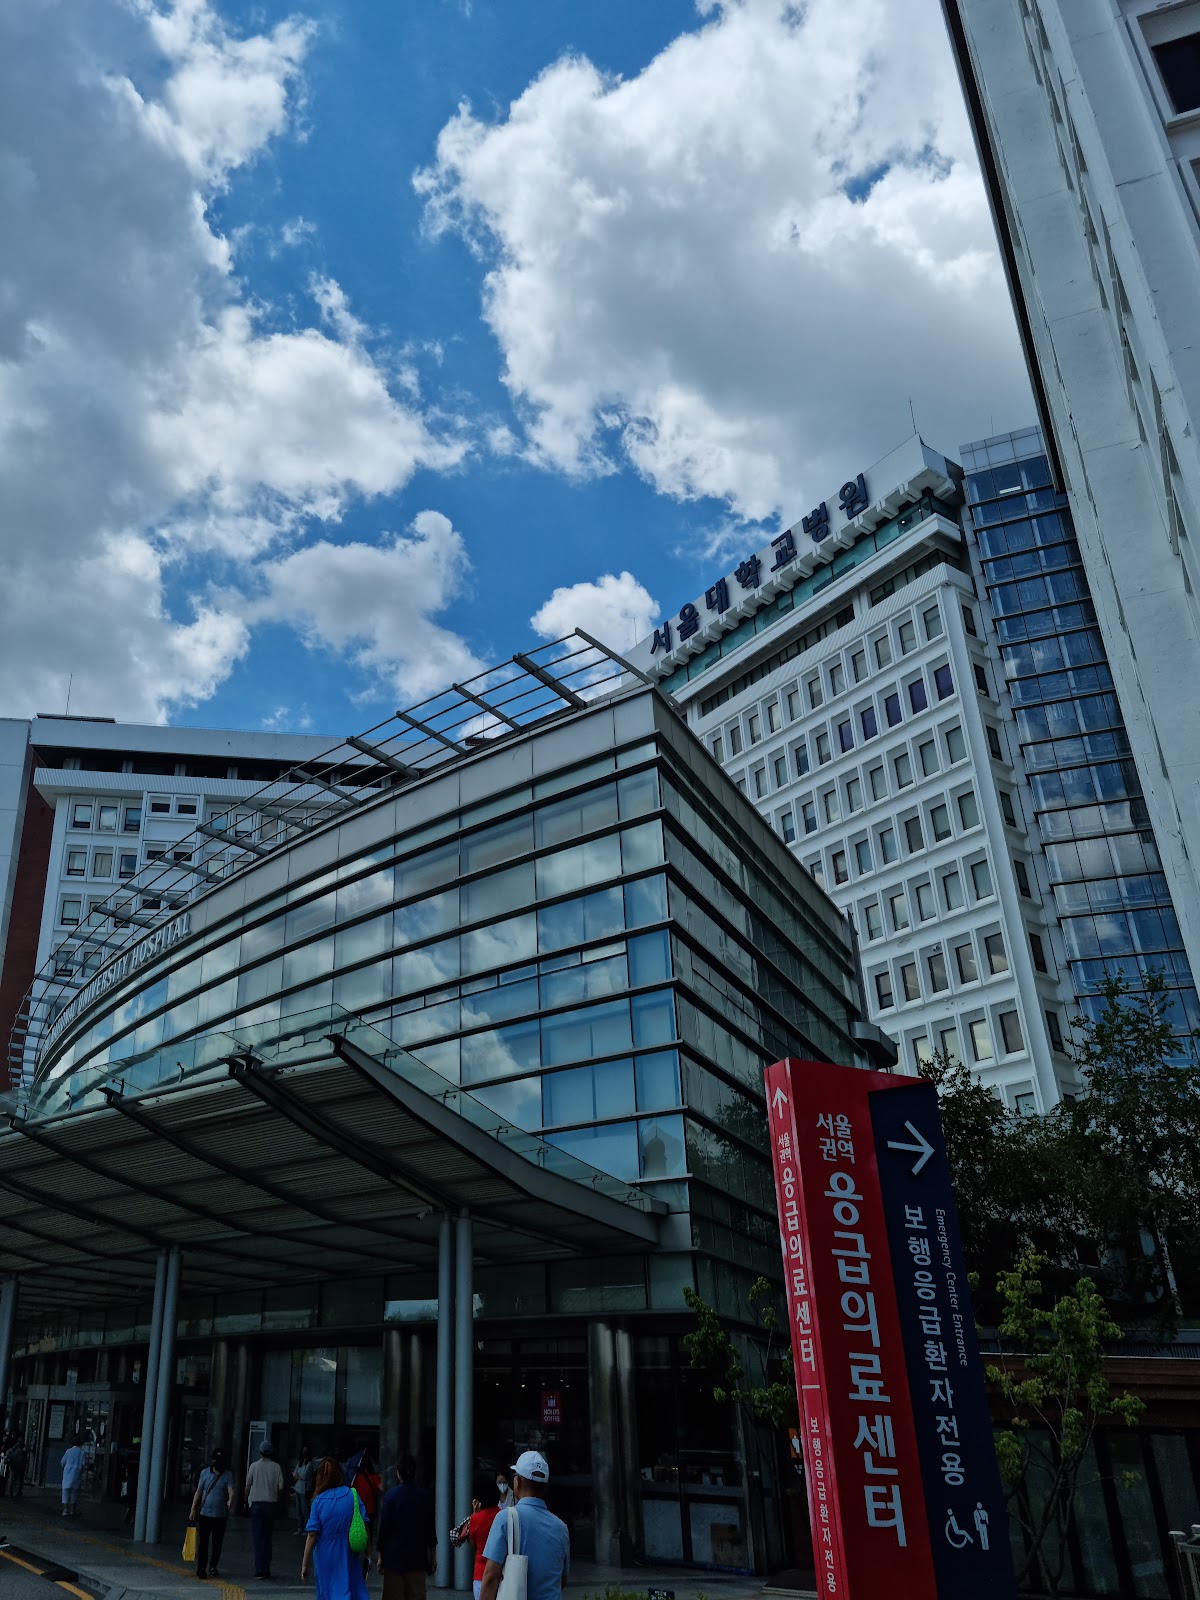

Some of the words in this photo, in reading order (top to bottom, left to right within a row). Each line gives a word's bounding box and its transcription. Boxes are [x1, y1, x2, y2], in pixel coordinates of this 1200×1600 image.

[650, 472, 870, 655] 서울대학교병원
[131, 912, 192, 970] HOSPITAL
[777, 1132, 790, 1148] 서울
[816, 1111, 853, 1139] 서울
[818, 1137, 856, 1165] 권역
[934, 1208, 953, 1269] Emergency
[781, 1166, 817, 1372] 응급의료센터
[944, 1271, 960, 1311] Center
[823, 1170, 908, 1548] 응급의료센터
[951, 1313, 969, 1367] Entrance
